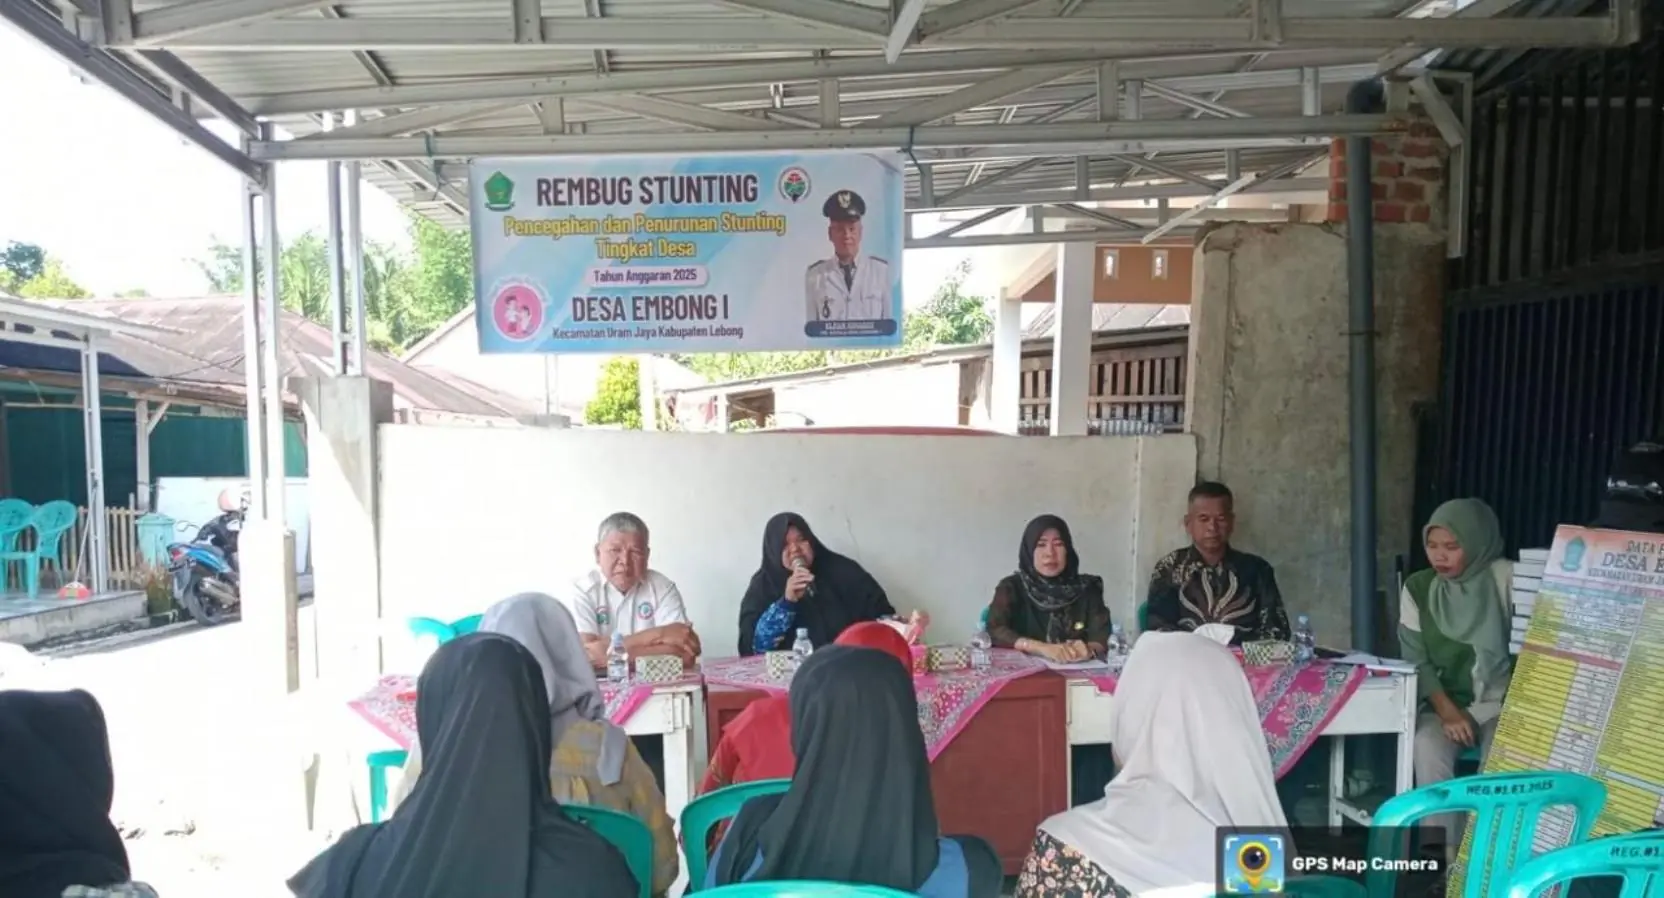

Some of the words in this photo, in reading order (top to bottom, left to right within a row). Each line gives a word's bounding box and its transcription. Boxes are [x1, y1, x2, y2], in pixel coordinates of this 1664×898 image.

[537, 178, 632, 206] REMBUG
[639, 175, 758, 205] STUNTING
[504, 214, 598, 240] Pencegahan
[602, 214, 632, 234] dan
[633, 213, 717, 234] Penurunan
[721, 211, 786, 236] Stunting
[595, 237, 653, 263] Tingkat
[658, 238, 696, 258] Desa
[594, 269, 623, 282] Tahun
[625, 269, 672, 285] Anggaran
[673, 268, 697, 281] 2025
[572, 295, 625, 321] DESA
[632, 294, 718, 321] EMBONG
[723, 294, 729, 319] I
[552, 328, 606, 340] Kecamatan
[607, 327, 633, 338] Uram
[634, 327, 657, 341] Jaya
[658, 326, 708, 340] Kabupaten
[709, 325, 744, 339] Lebong
[1601, 551, 1648, 571] DESA
